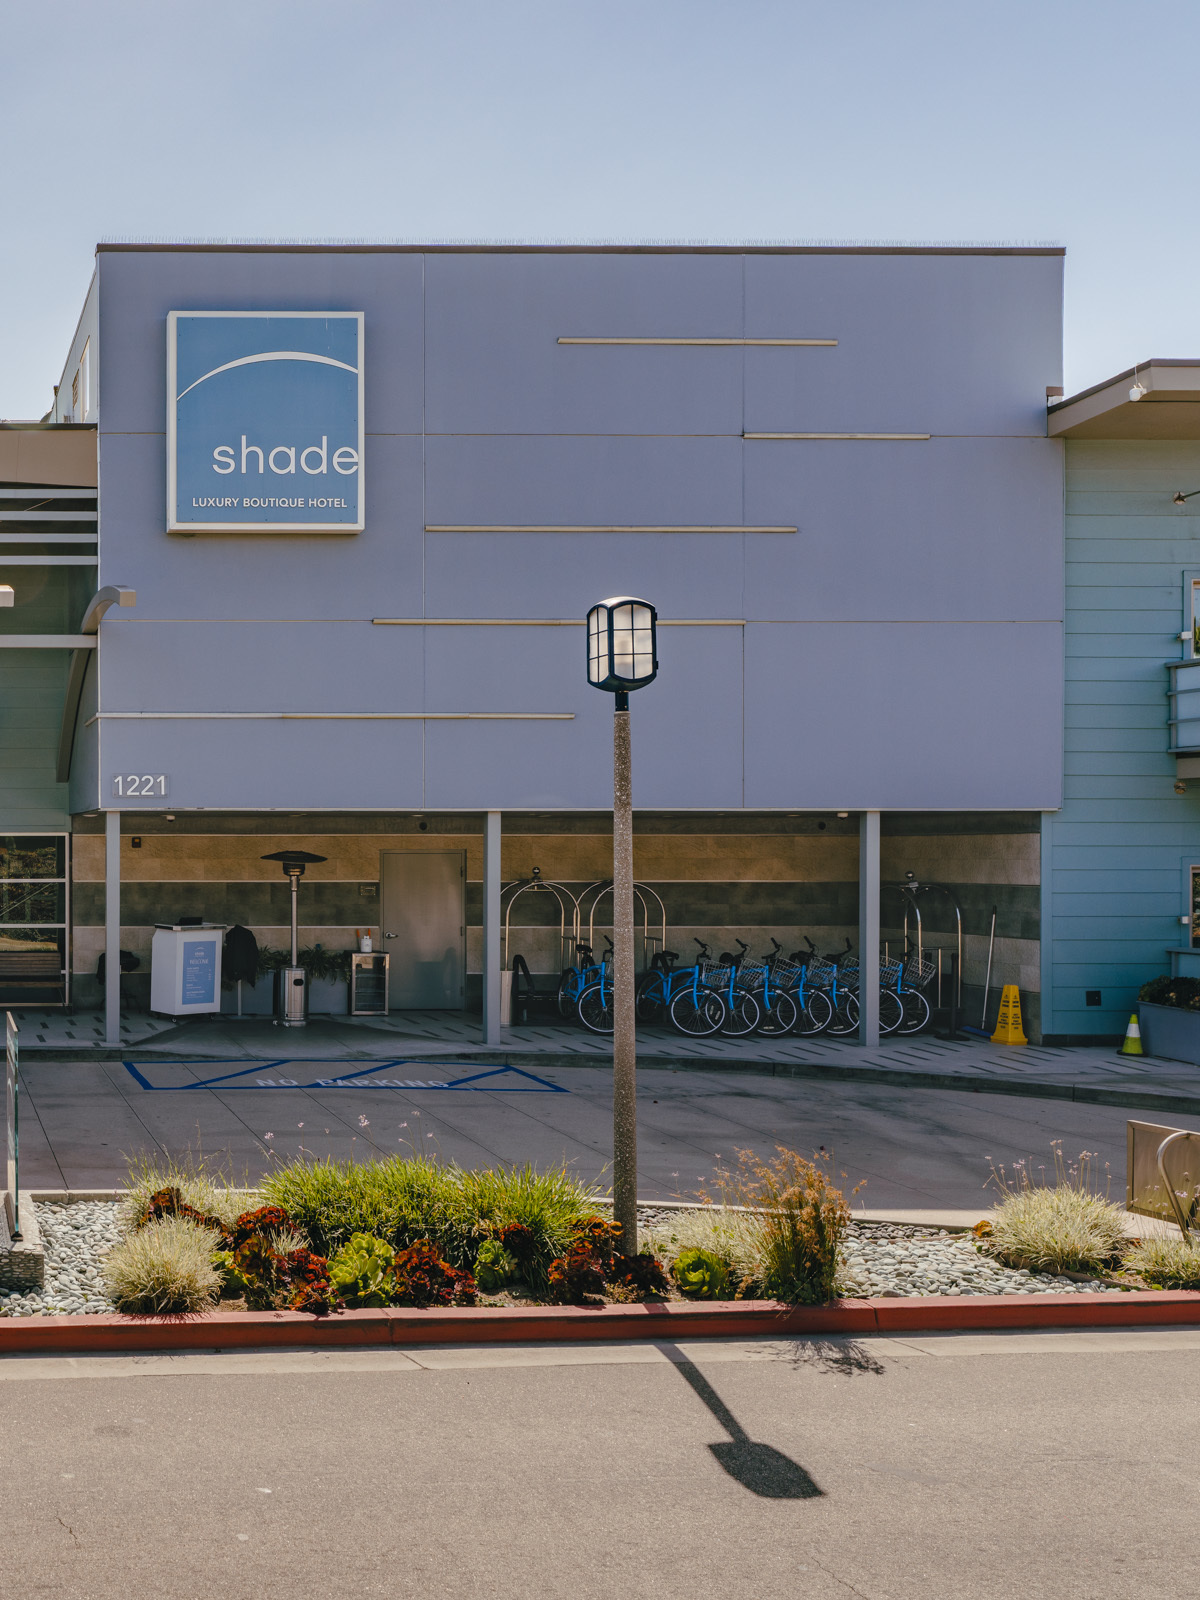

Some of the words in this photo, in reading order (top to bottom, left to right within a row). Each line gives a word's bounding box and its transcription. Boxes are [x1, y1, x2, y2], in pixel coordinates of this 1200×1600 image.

[212, 435, 359, 475] shade
[192, 497, 240, 508] LUXURY
[243, 497, 305, 509] BOUTIQUE
[308, 498, 348, 509] HOTEL
[114, 776, 165, 796] 1221
[256, 1078, 298, 1086] NO
[315, 1078, 450, 1088] PARKING
